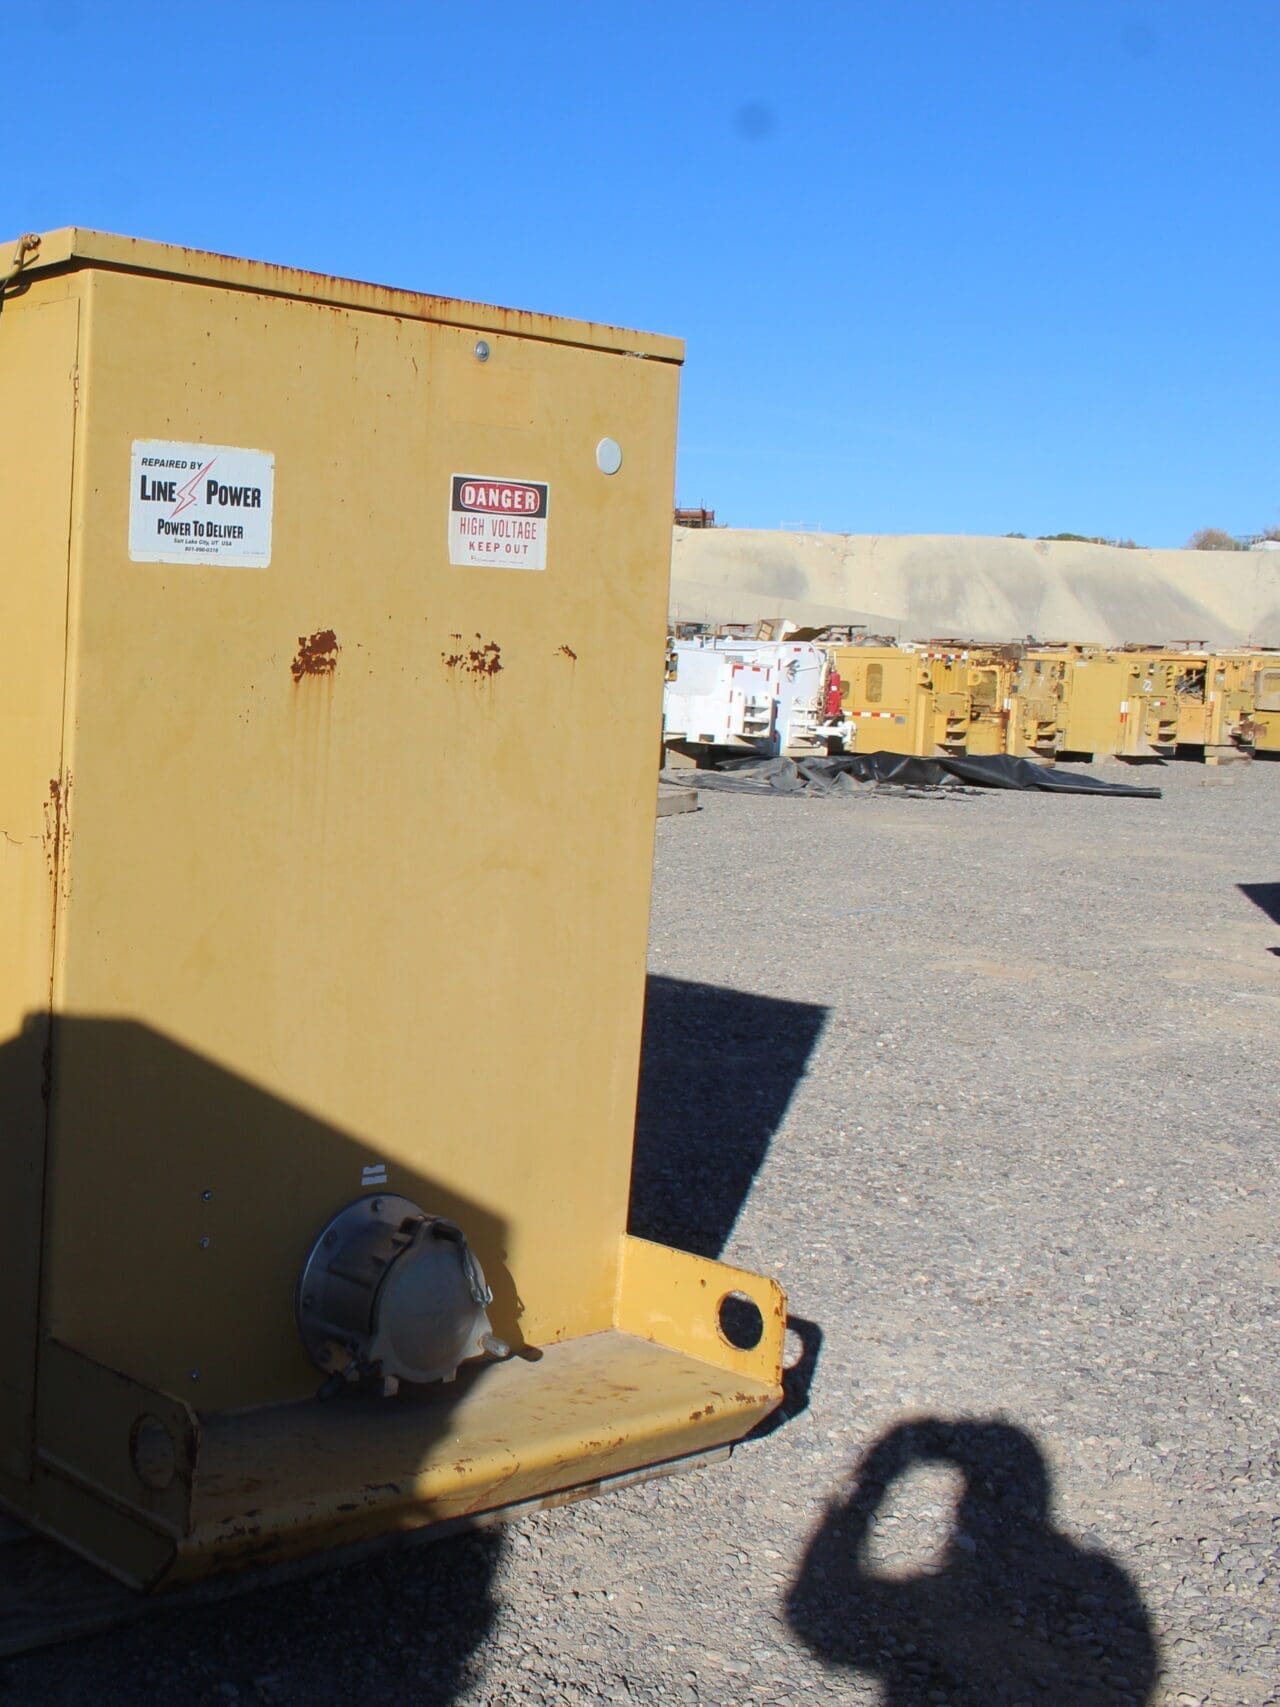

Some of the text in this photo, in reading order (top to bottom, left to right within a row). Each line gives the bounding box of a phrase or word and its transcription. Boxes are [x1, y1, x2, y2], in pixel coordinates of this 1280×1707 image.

[141, 457, 203, 470] REPAIRED BY
[464, 486, 536, 510] DANGER
[460, 517, 537, 540] HIGH VOLTAGE
[469, 541, 528, 554] KEEP OUT
